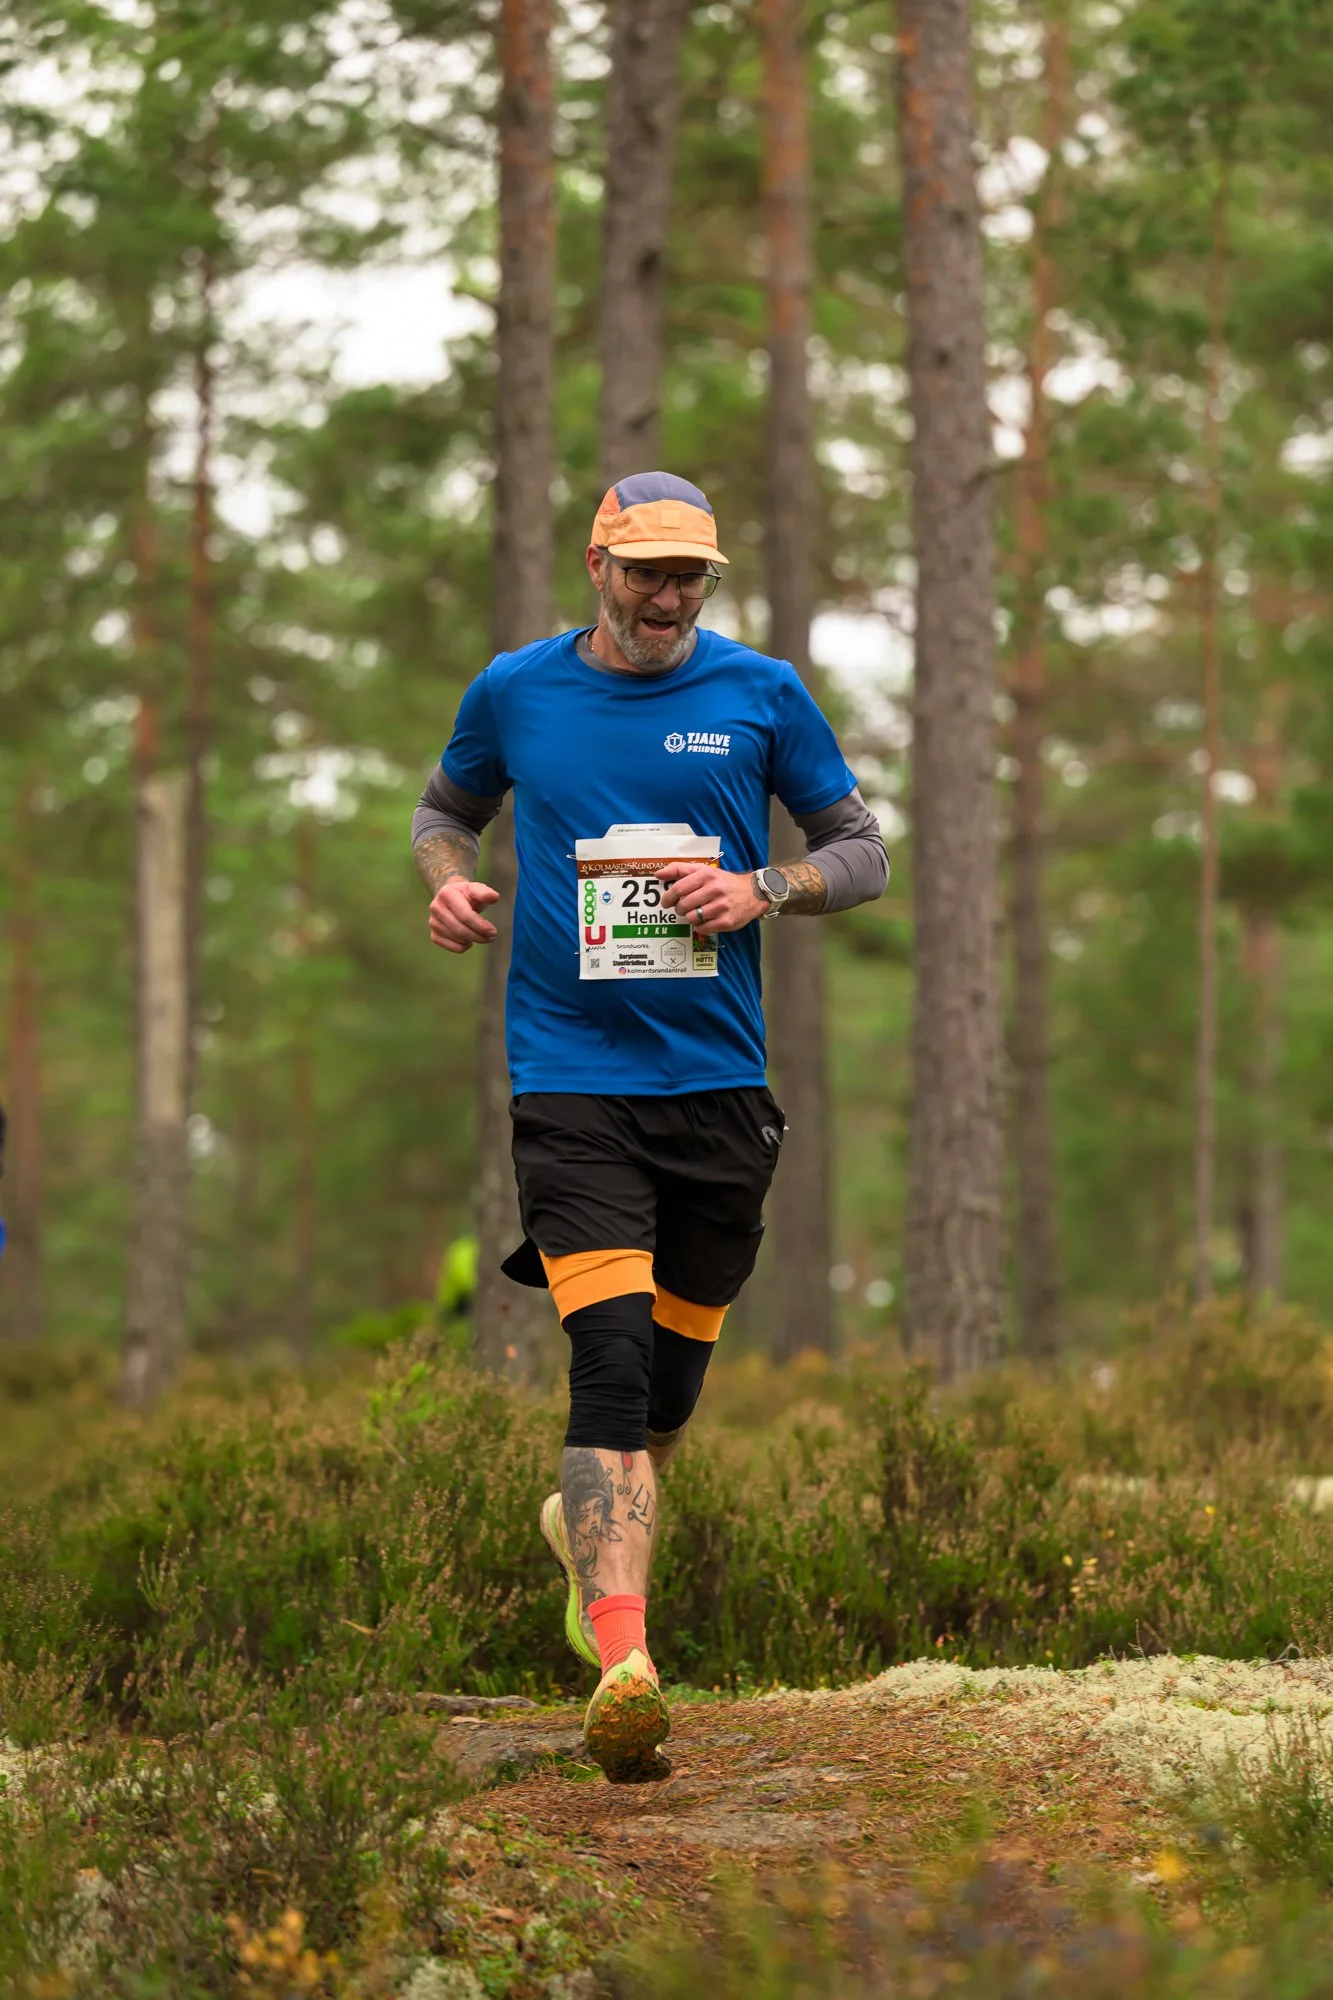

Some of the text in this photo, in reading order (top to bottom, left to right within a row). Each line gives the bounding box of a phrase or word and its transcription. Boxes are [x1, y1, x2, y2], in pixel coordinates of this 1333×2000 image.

[687, 732, 731, 747] TJALVE
[687, 745, 730, 756] FRIIDROTT
[584, 880, 597, 925] coop
[627, 910, 677, 924] Henke
[637, 927, 668, 935] 10 KM
